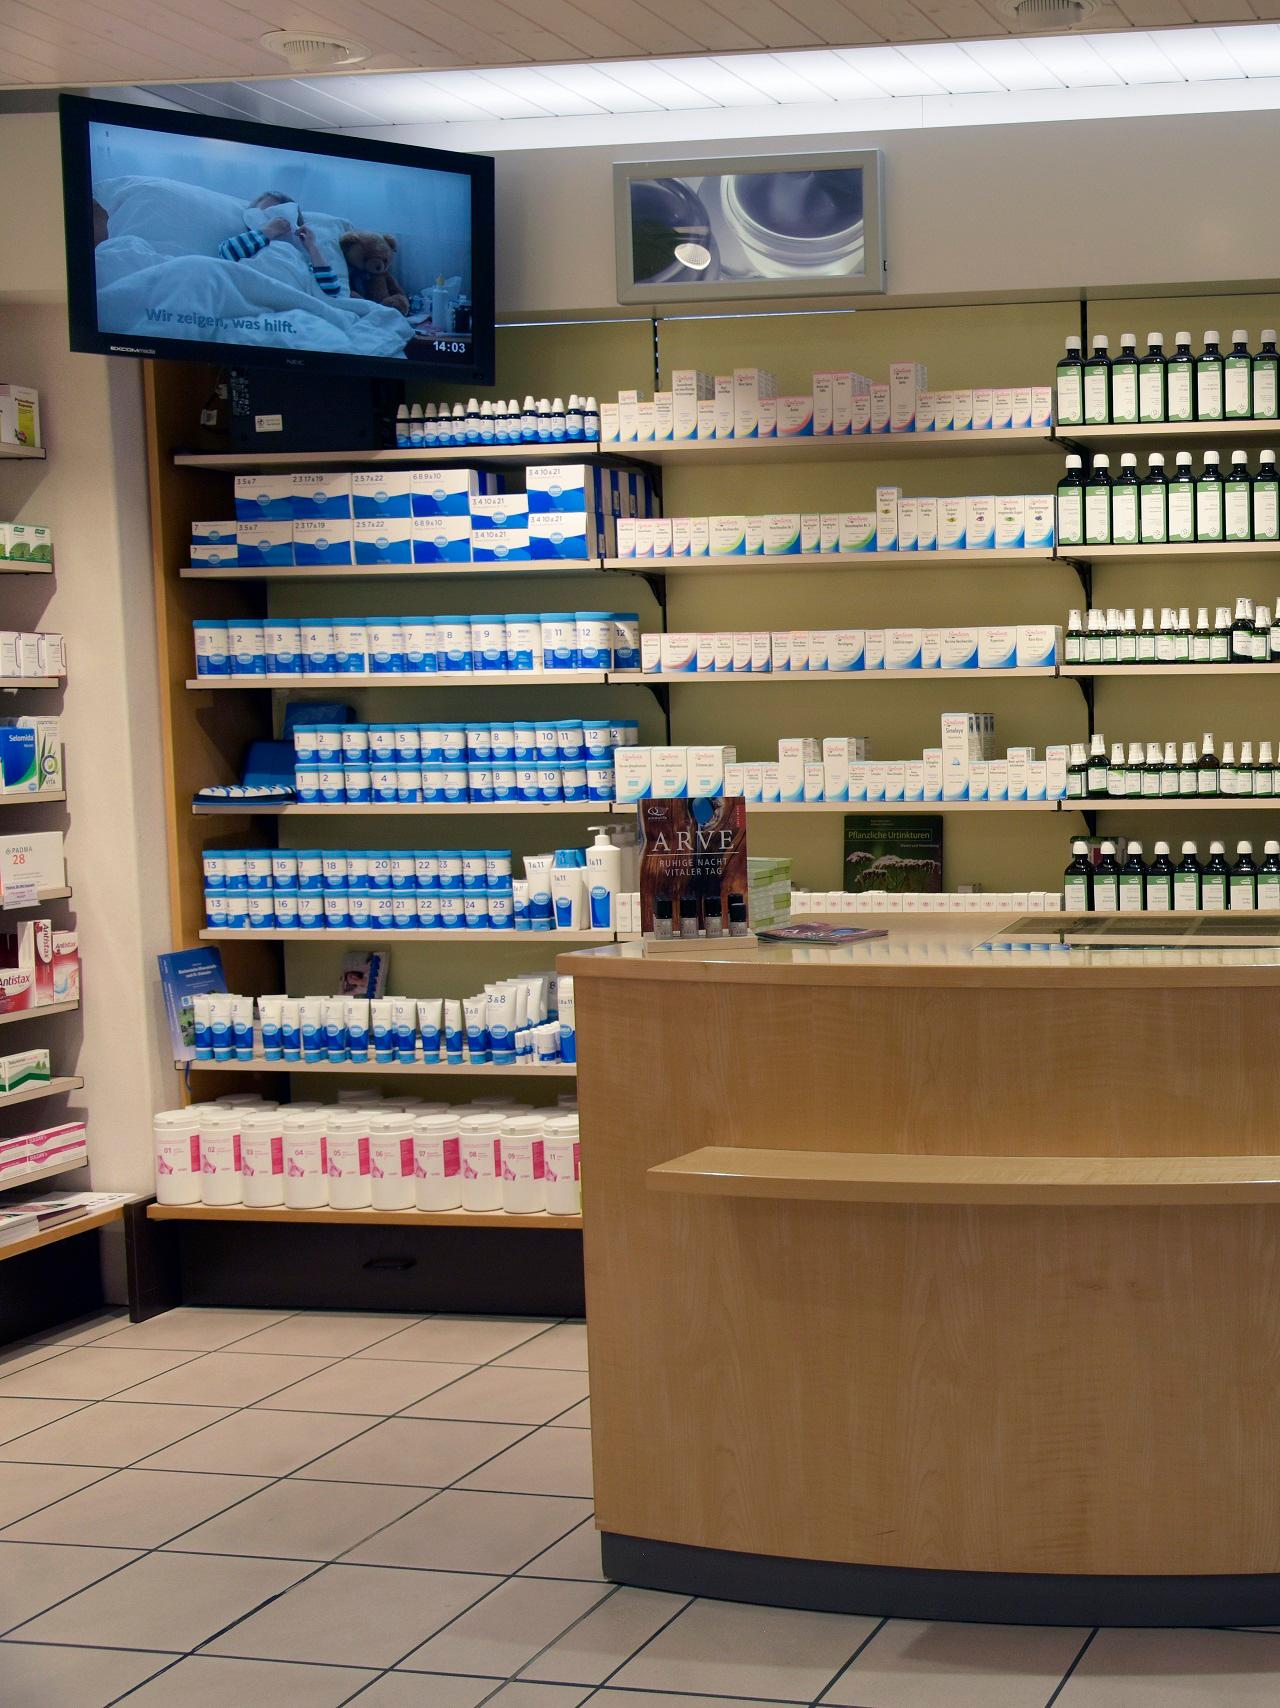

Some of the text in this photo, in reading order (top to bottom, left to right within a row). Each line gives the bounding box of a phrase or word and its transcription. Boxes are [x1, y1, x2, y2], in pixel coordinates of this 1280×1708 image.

[145, 308, 298, 334] Wir zeigen, was hilft.
[432, 340, 466, 353] 14:03
[848, 830, 930, 840] Pflanzliche Urtinkturen
[652, 830, 735, 852] ARVE
[13, 854, 26, 864] 28
[659, 858, 728, 868] RUHIGE NACHT
[665, 867, 722, 877] VITALER TAG
